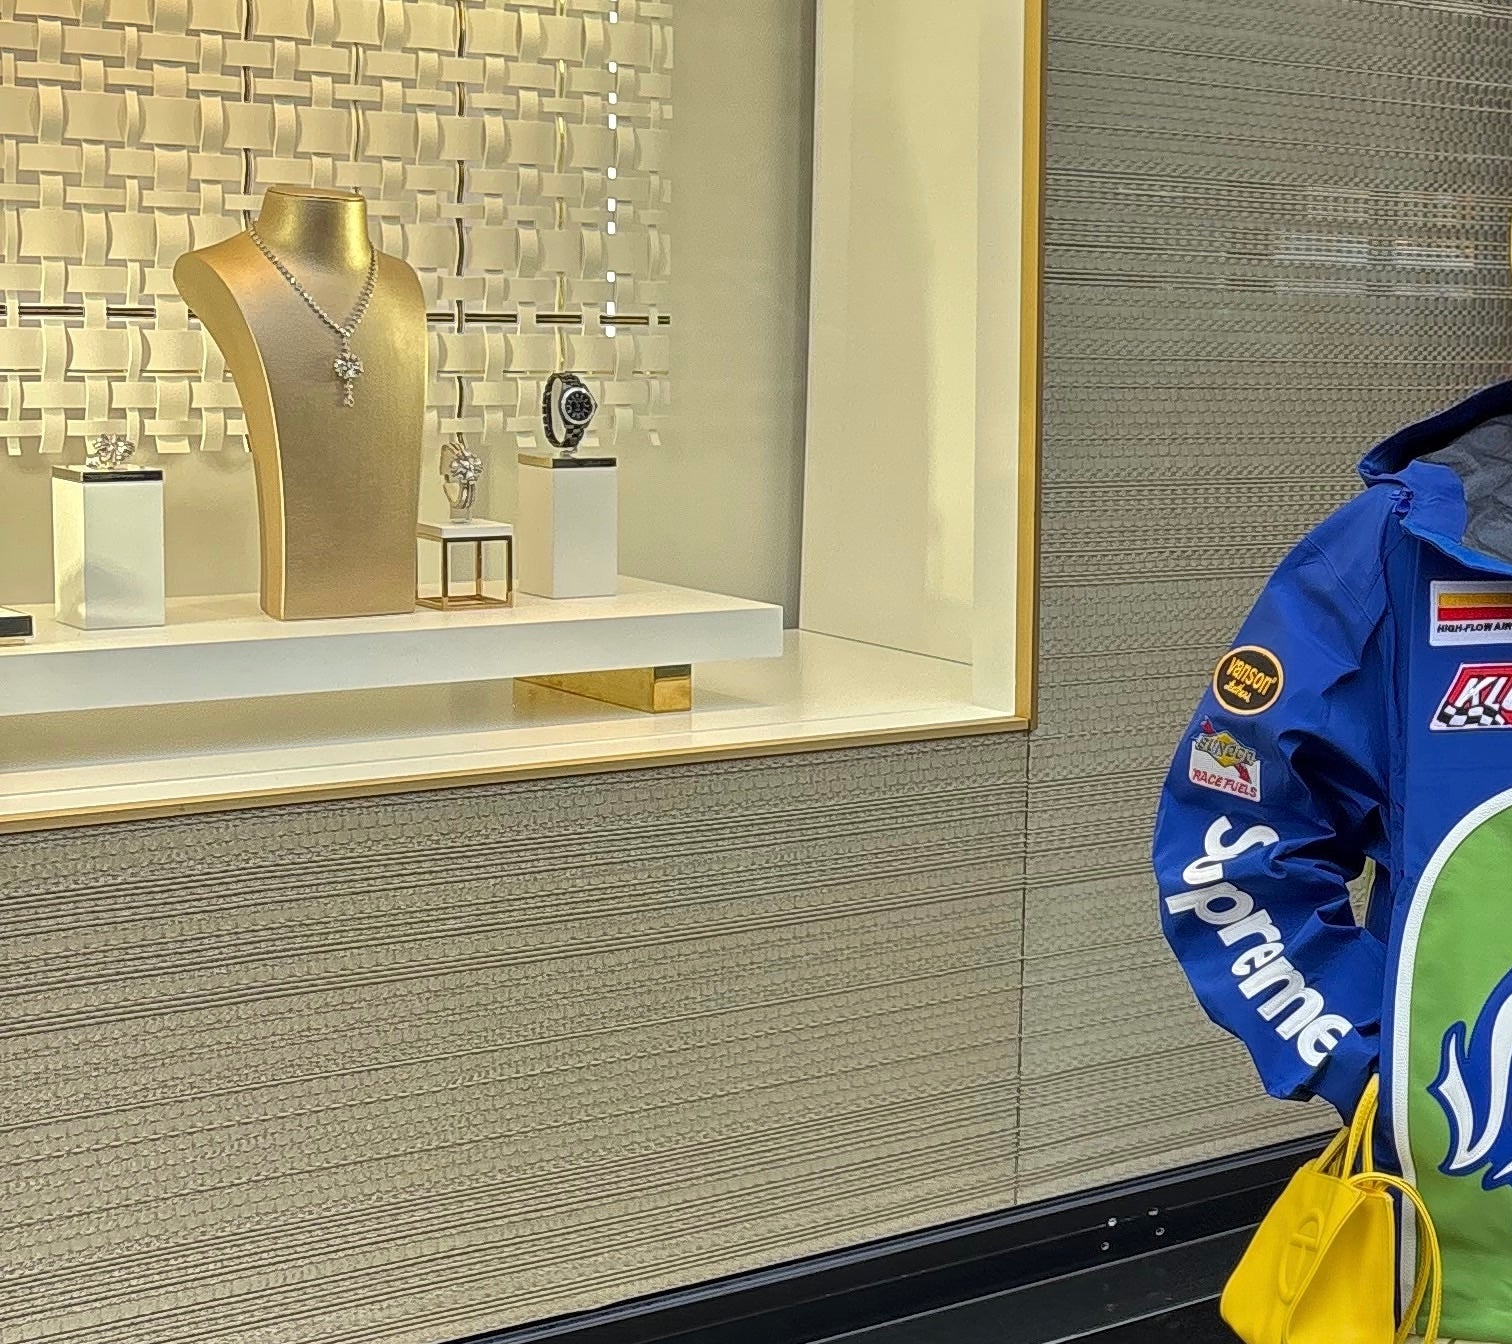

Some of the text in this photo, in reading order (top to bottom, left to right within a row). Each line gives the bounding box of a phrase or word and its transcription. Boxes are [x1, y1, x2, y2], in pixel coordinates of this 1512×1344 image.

[1494, 622, 1512, 632] AIR
[1193, 768, 1258, 798] RACE FUELS
